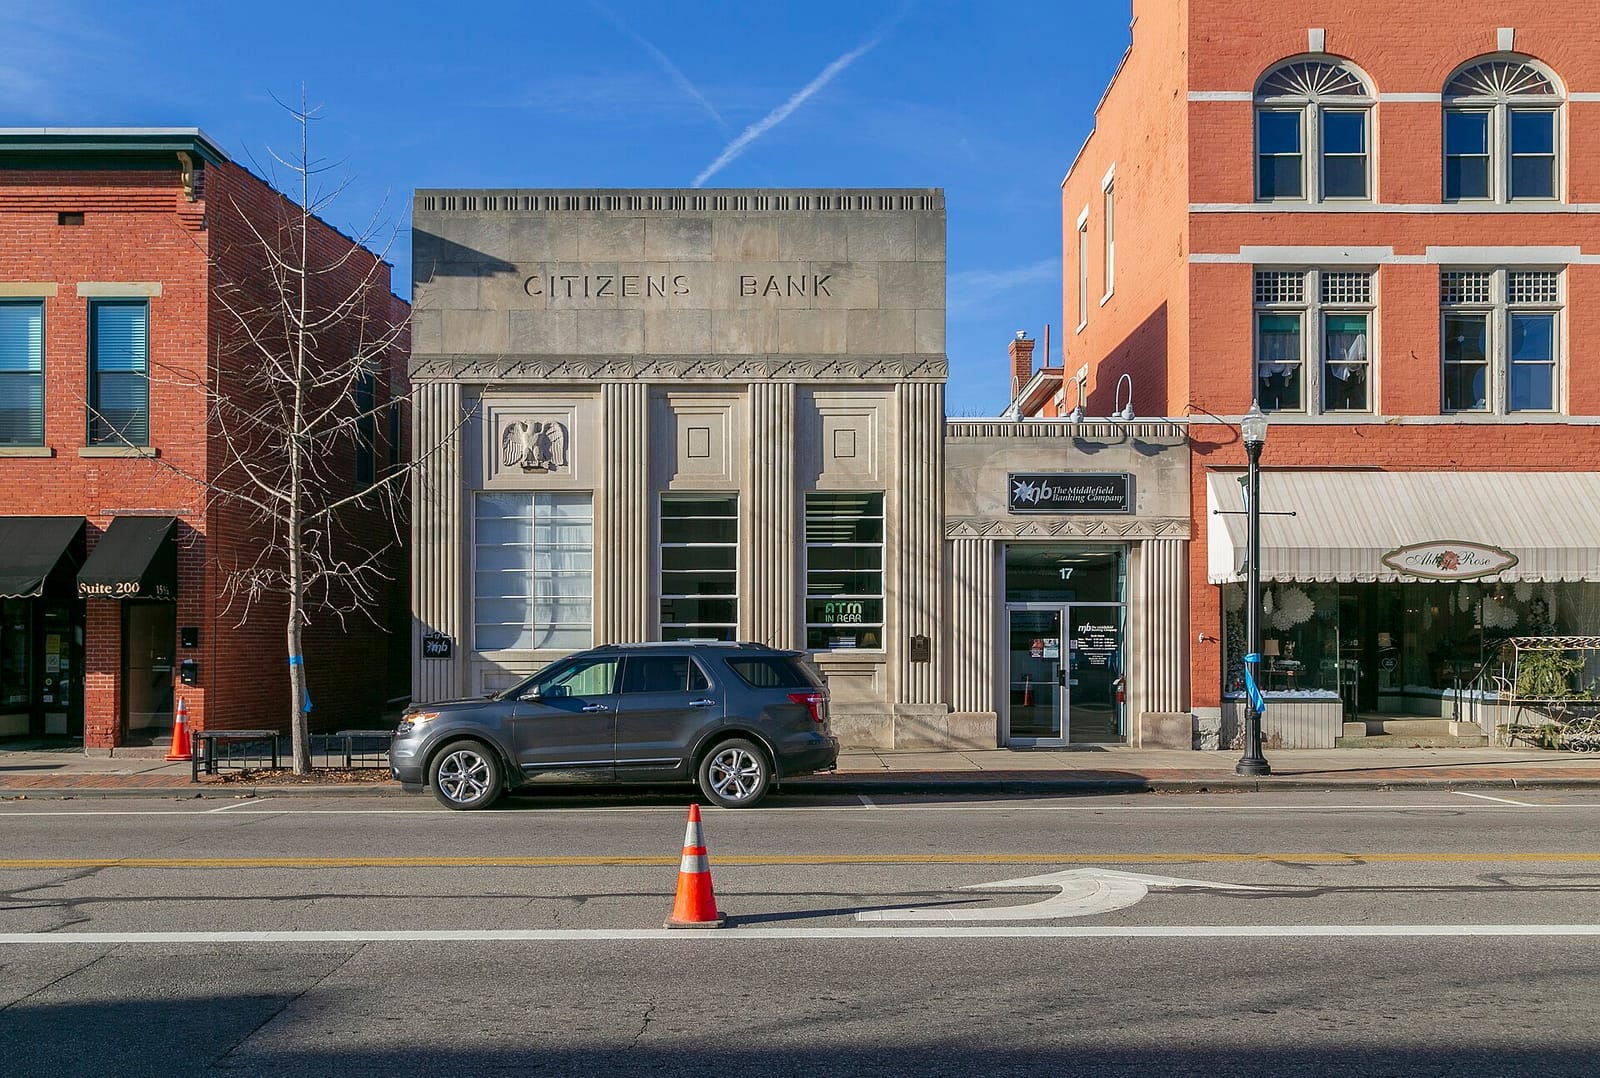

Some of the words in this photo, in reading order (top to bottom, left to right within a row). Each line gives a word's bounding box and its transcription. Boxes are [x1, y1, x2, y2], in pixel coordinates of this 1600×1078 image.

[523, 275, 691, 297] CITIZENS
[740, 275, 834, 297] BANK
[1052, 486, 1067, 495] The
[1067, 485, 1114, 495] Middlefield
[1052, 494, 1085, 504] Banking
[1087, 494, 1124, 504] Company
[1458, 551, 1491, 565] Rose
[1059, 567, 1073, 580] 17
[79, 582, 113, 593] Suite
[116, 582, 140, 593] 200
[825, 602, 862, 614] ATM
[825, 614, 834, 623] IN
[837, 614, 862, 623] REAR
